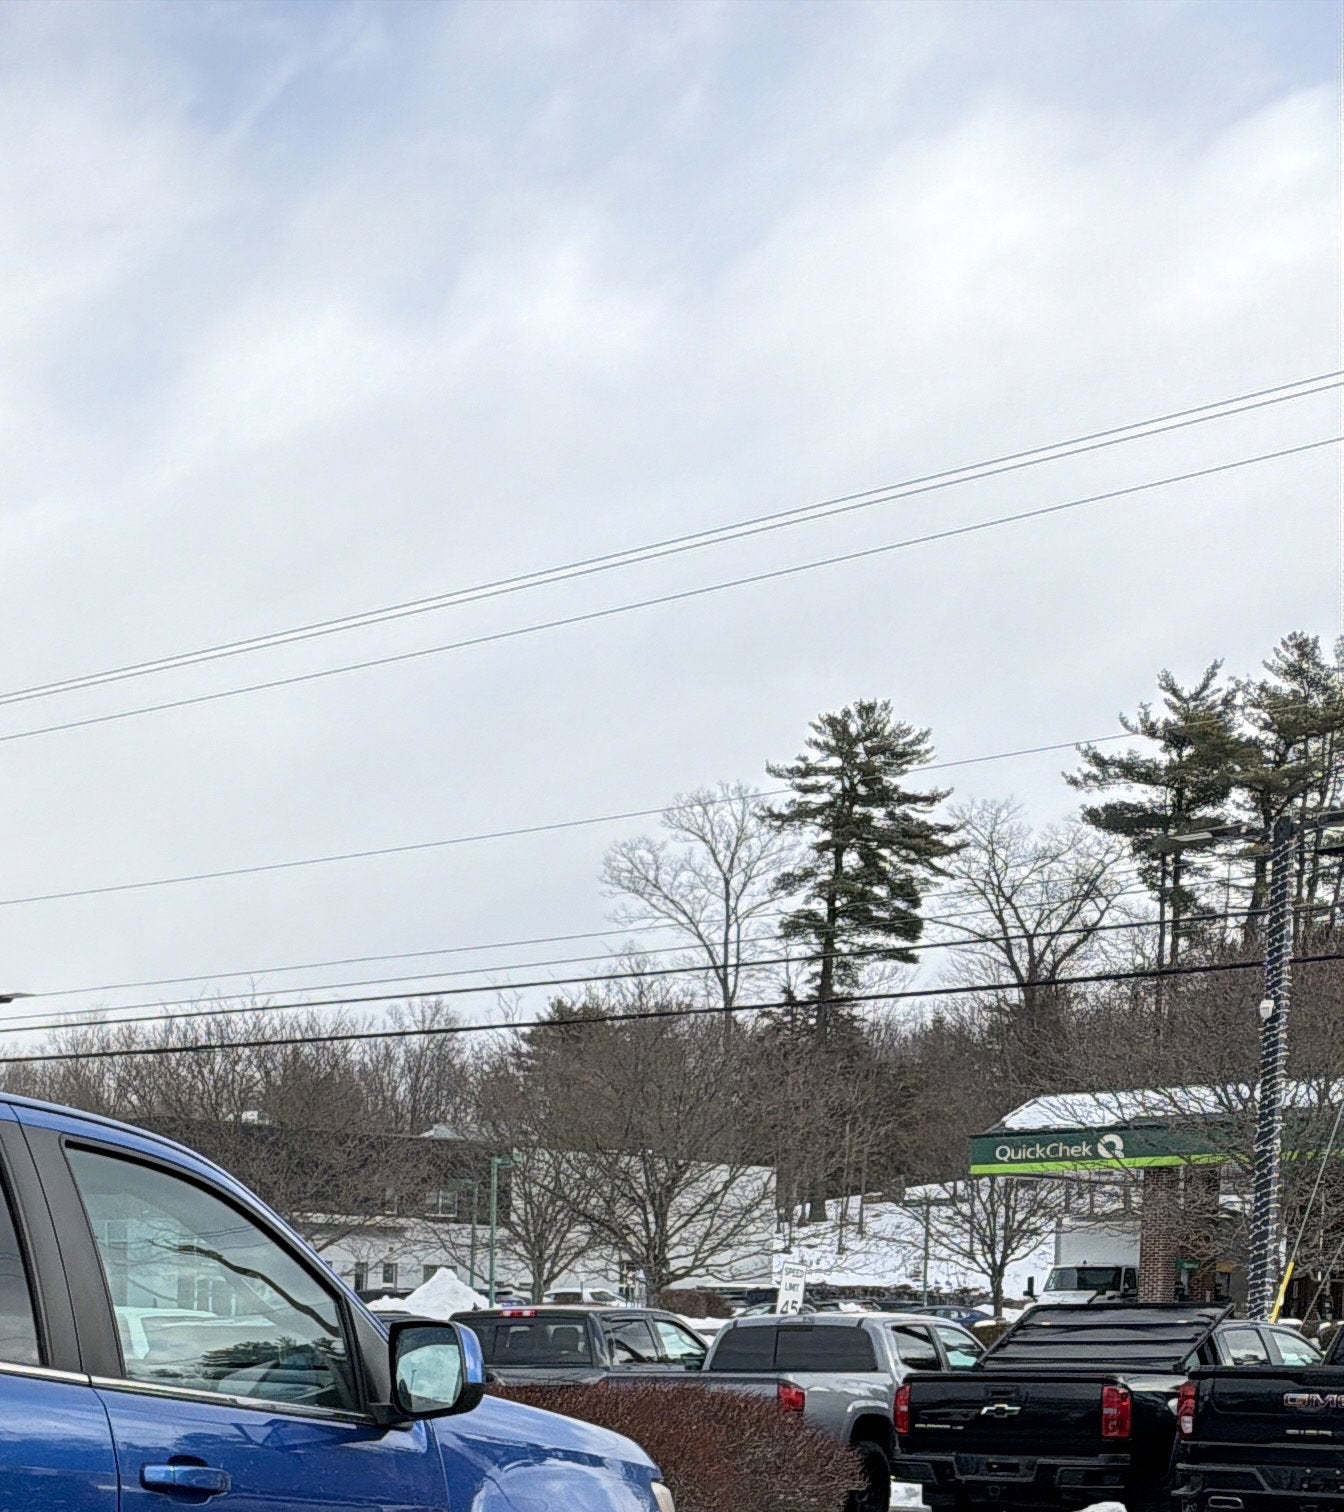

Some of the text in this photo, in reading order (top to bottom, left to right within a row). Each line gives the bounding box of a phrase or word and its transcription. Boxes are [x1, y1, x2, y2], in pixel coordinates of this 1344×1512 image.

[995, 1141, 1092, 1162] QuickChek
[784, 1266, 805, 1279] SPEED
[784, 1281, 800, 1292] LIMIT
[780, 1300, 799, 1315] 45
[1283, 1393, 1344, 1409] GM
